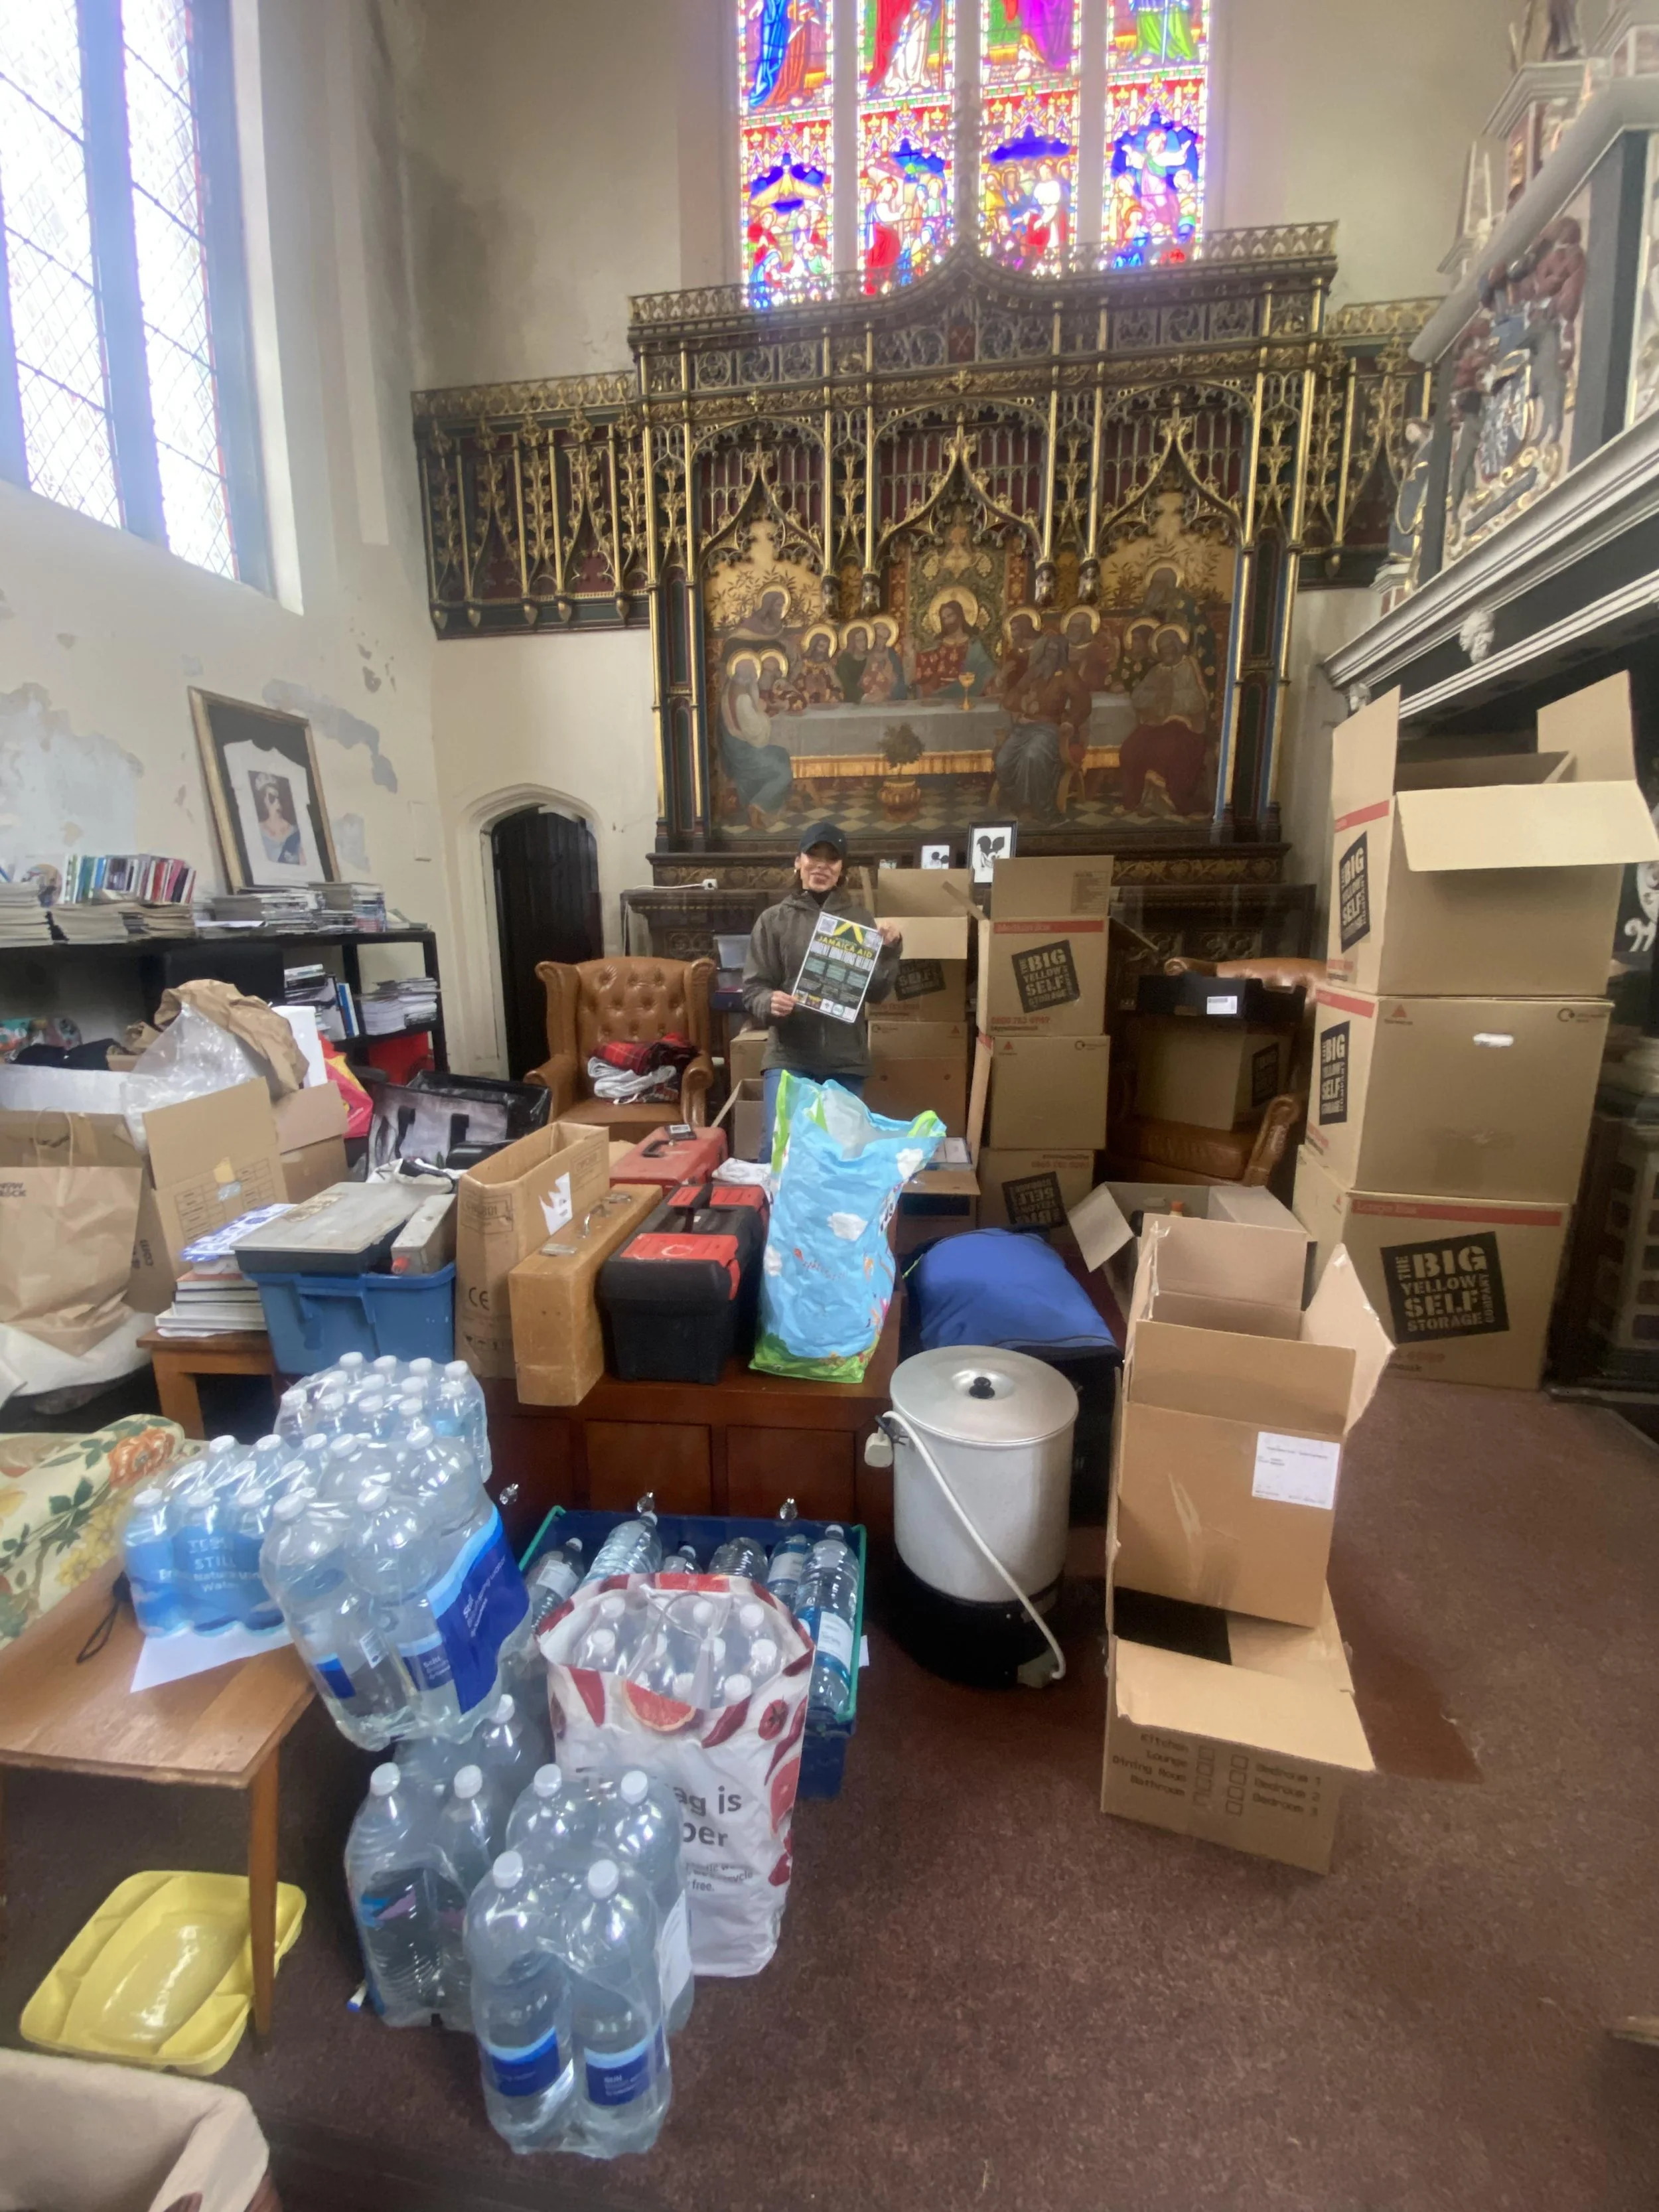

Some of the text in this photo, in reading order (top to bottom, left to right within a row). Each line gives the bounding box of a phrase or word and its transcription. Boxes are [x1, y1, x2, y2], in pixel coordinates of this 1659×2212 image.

[1344, 847, 1364, 886] BIG
[1342, 893, 1362, 927] SELF
[818, 935, 855, 953] JAMAICA
[857, 948, 873, 959] AID
[1028, 948, 1067, 972] BIG
[1023, 967, 1063, 984] YELLOW
[1025, 975, 1064, 997] SELF
[1325, 1033, 1346, 1063] BIG
[1322, 1077, 1341, 1101] SELF
[1396, 1255, 1411, 1281] THE
[1412, 1246, 1488, 1279] BIG
[1401, 1274, 1479, 1296] YELLOW
[1404, 1290, 1479, 1318] SELF
[1407, 1311, 1483, 1333] STORAGE
[1140, 1733, 1189, 1753] Kitchen
[1112, 1755, 1152, 1775] Dining
[1146, 1749, 1188, 1767] Lounge
[1130, 1774, 1186, 1797] Bathroom
[1256, 1762, 1322, 1787] Bedroom 1
[1254, 1777, 1306, 1799] Bedroom
[673, 1785, 743, 1817] ag is
[1253, 1793, 1304, 1813] Bedroom
[692, 1879, 715, 1891] free.
